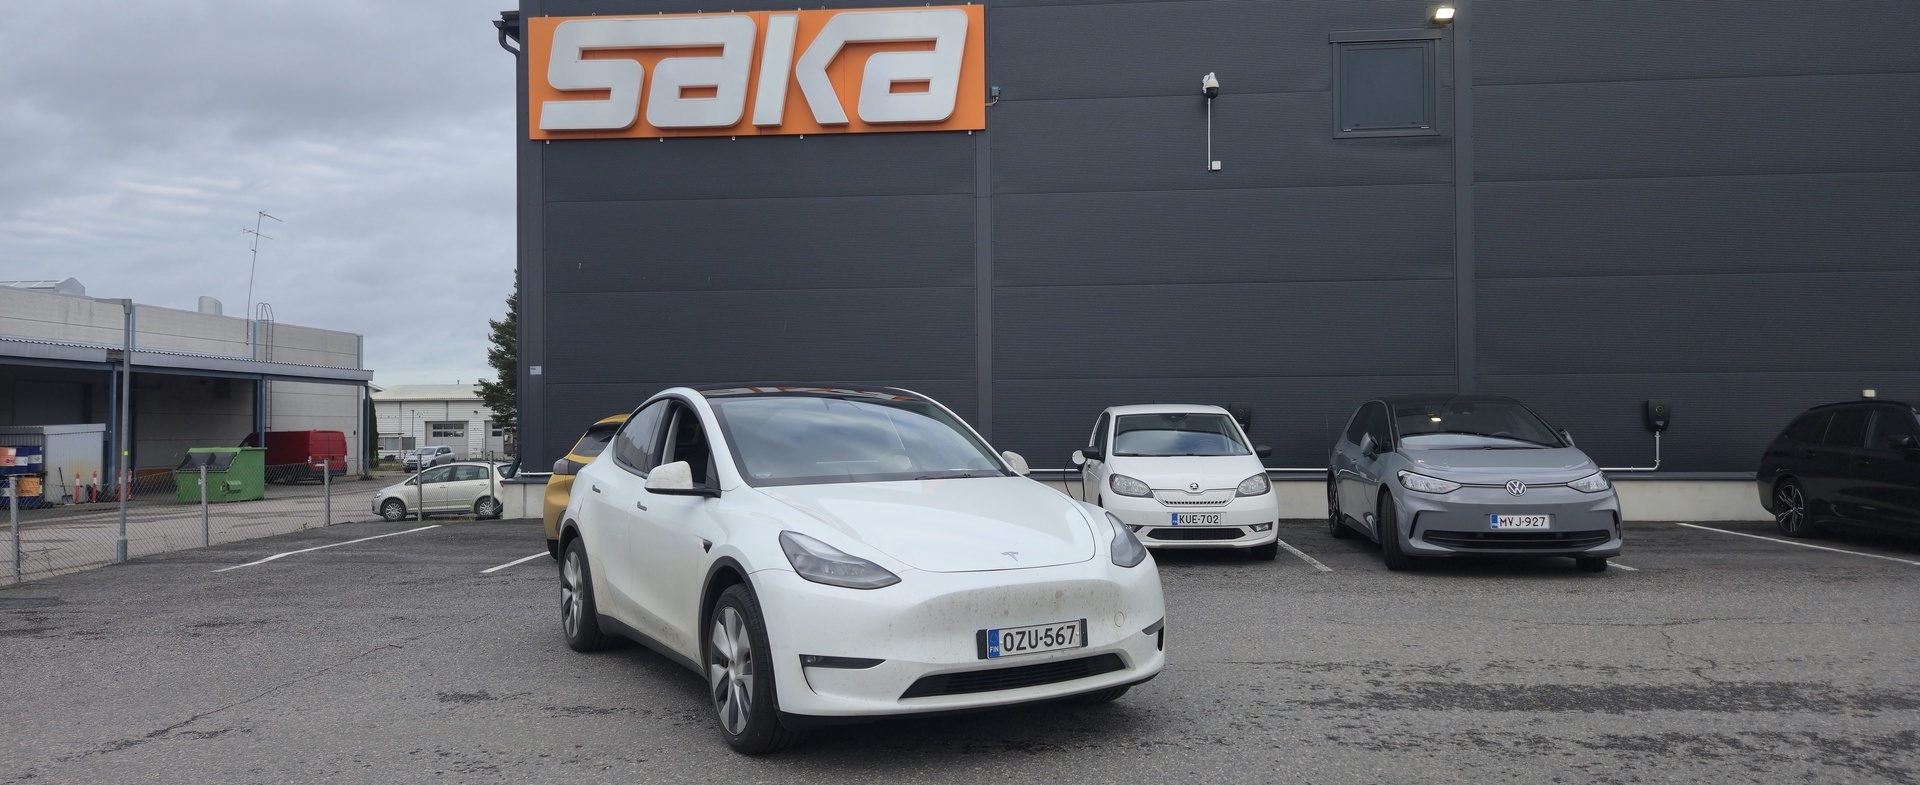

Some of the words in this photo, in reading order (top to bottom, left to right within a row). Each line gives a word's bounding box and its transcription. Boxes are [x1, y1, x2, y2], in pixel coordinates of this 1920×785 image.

[1179, 514, 1219, 524] KUE-702
[1499, 516, 1546, 527] MVJ-927
[1003, 624, 1076, 652] OZU-567
[989, 645, 999, 653] FIN
